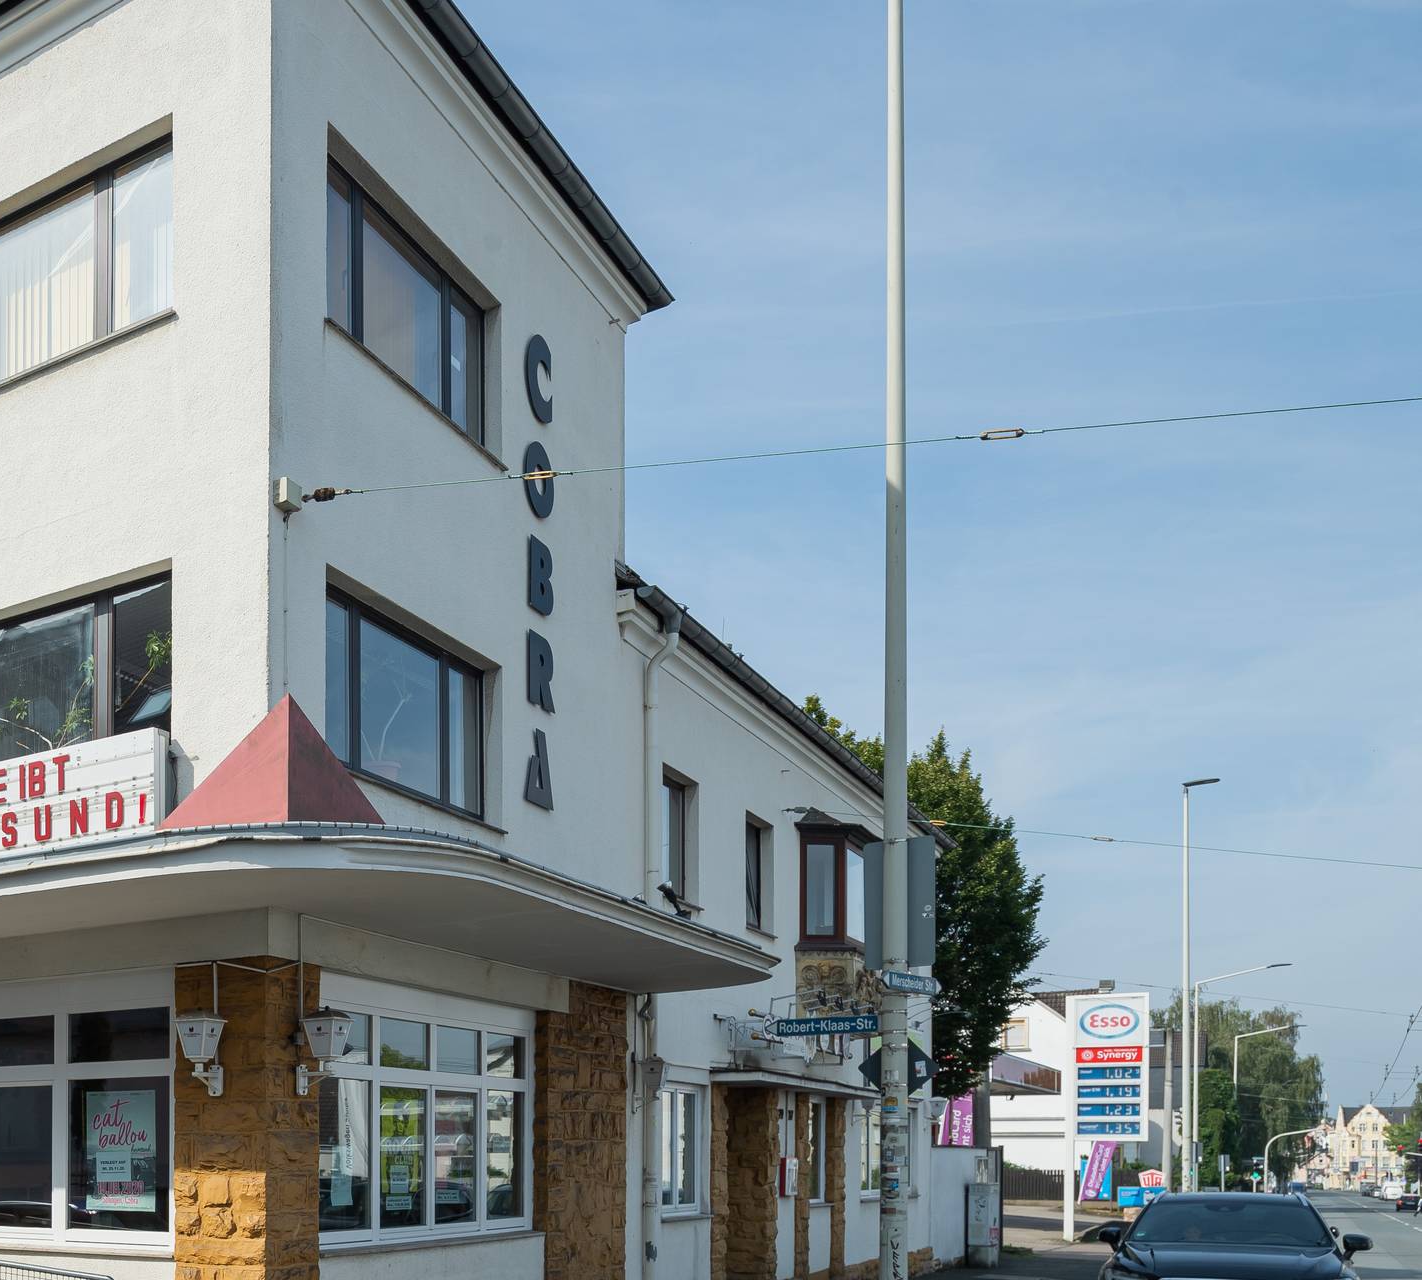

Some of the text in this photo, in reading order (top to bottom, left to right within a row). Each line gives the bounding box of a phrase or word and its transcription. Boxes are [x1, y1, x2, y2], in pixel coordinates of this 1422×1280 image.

[523, 334, 555, 811] COBRA
[779, 1018, 876, 1033] Robert-Klaas-Str.
[1089, 1014, 1130, 1028] Esso
[1097, 1050, 1138, 1060] Synergy
[94, 1099, 130, 1129] cat
